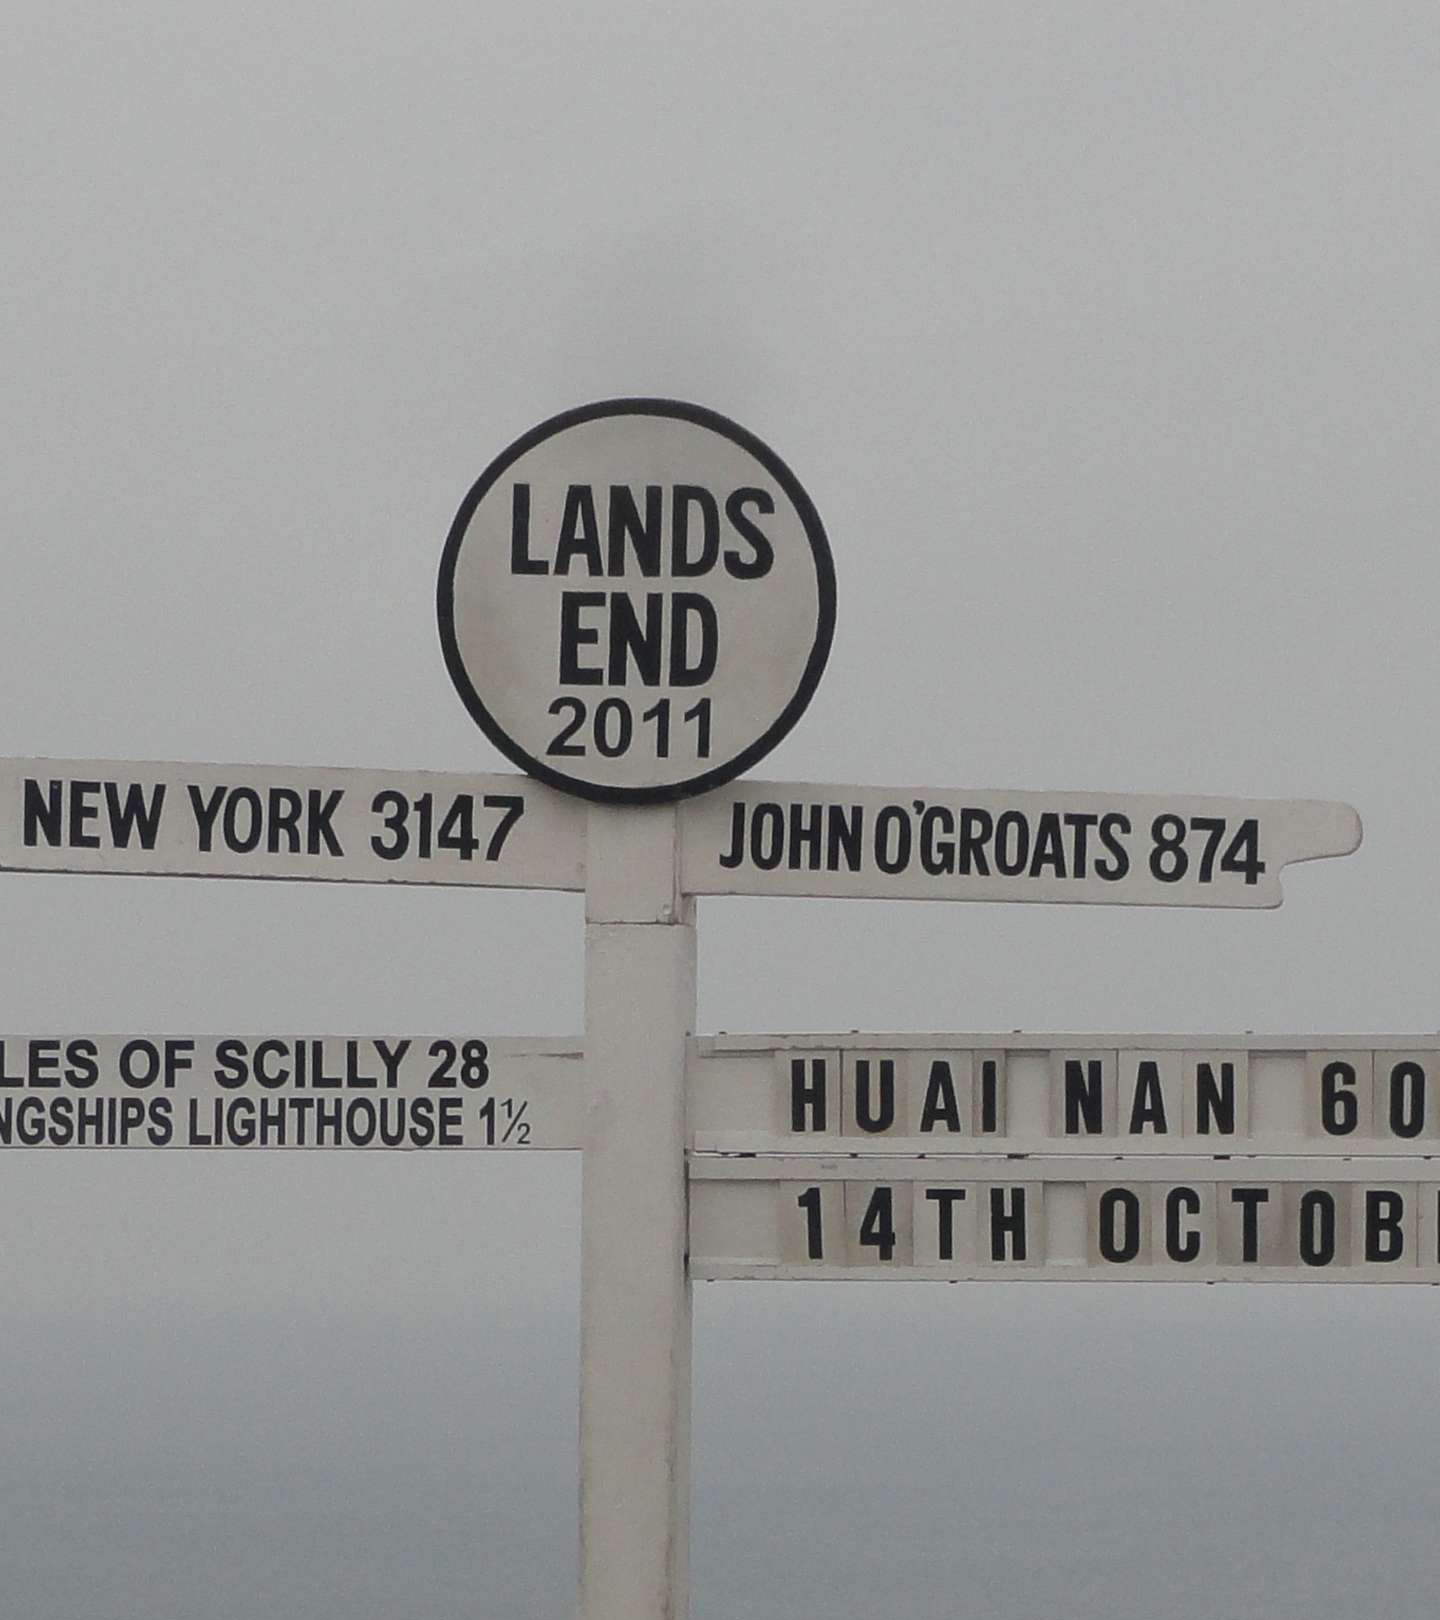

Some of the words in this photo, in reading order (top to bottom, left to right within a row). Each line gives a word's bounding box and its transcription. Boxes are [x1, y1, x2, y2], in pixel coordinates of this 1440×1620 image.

[510, 483, 775, 580] LANDS
[559, 591, 719, 688] END
[545, 696, 712, 759] 2011
[23, 778, 167, 850] NEW
[186, 784, 345, 857] YORK
[370, 789, 525, 862] 3147
[719, 801, 864, 872] JOHN
[874, 799, 1132, 882] O'GROATS
[1149, 813, 1266, 885] 874
[119, 1039, 195, 1089] OF
[213, 1039, 412, 1089] SCILLY
[427, 1039, 489, 1089] 28
[789, 1058, 997, 1136] HUAI
[1064, 1059, 1235, 1135] NAN
[188, 1096, 464, 1147] LIGHTHOUSE
[797, 1186, 1027, 1262] 14TH
